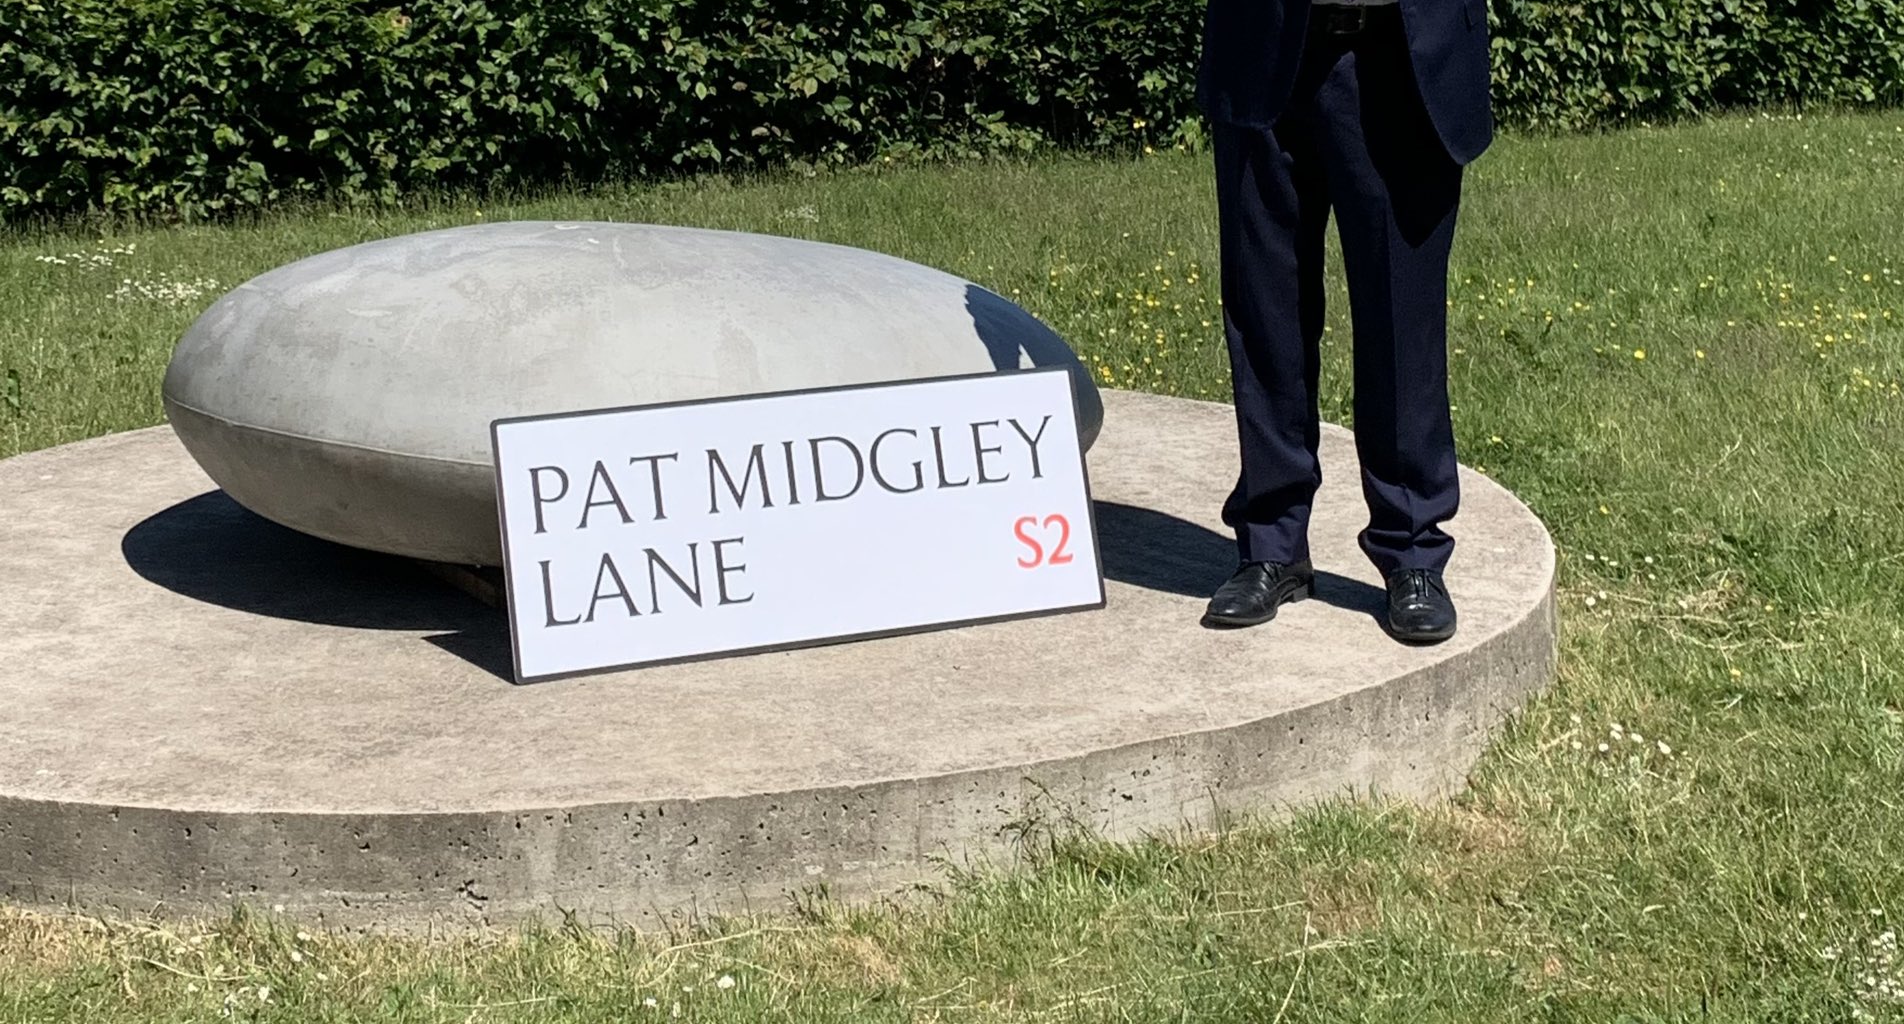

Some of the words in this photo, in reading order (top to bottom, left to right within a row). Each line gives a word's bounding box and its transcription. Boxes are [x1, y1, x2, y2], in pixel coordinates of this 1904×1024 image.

[526, 451, 679, 535] PAT
[706, 414, 1054, 515] MIDGLEY
[538, 536, 755, 629] LANE
[1013, 513, 1075, 570] S2
